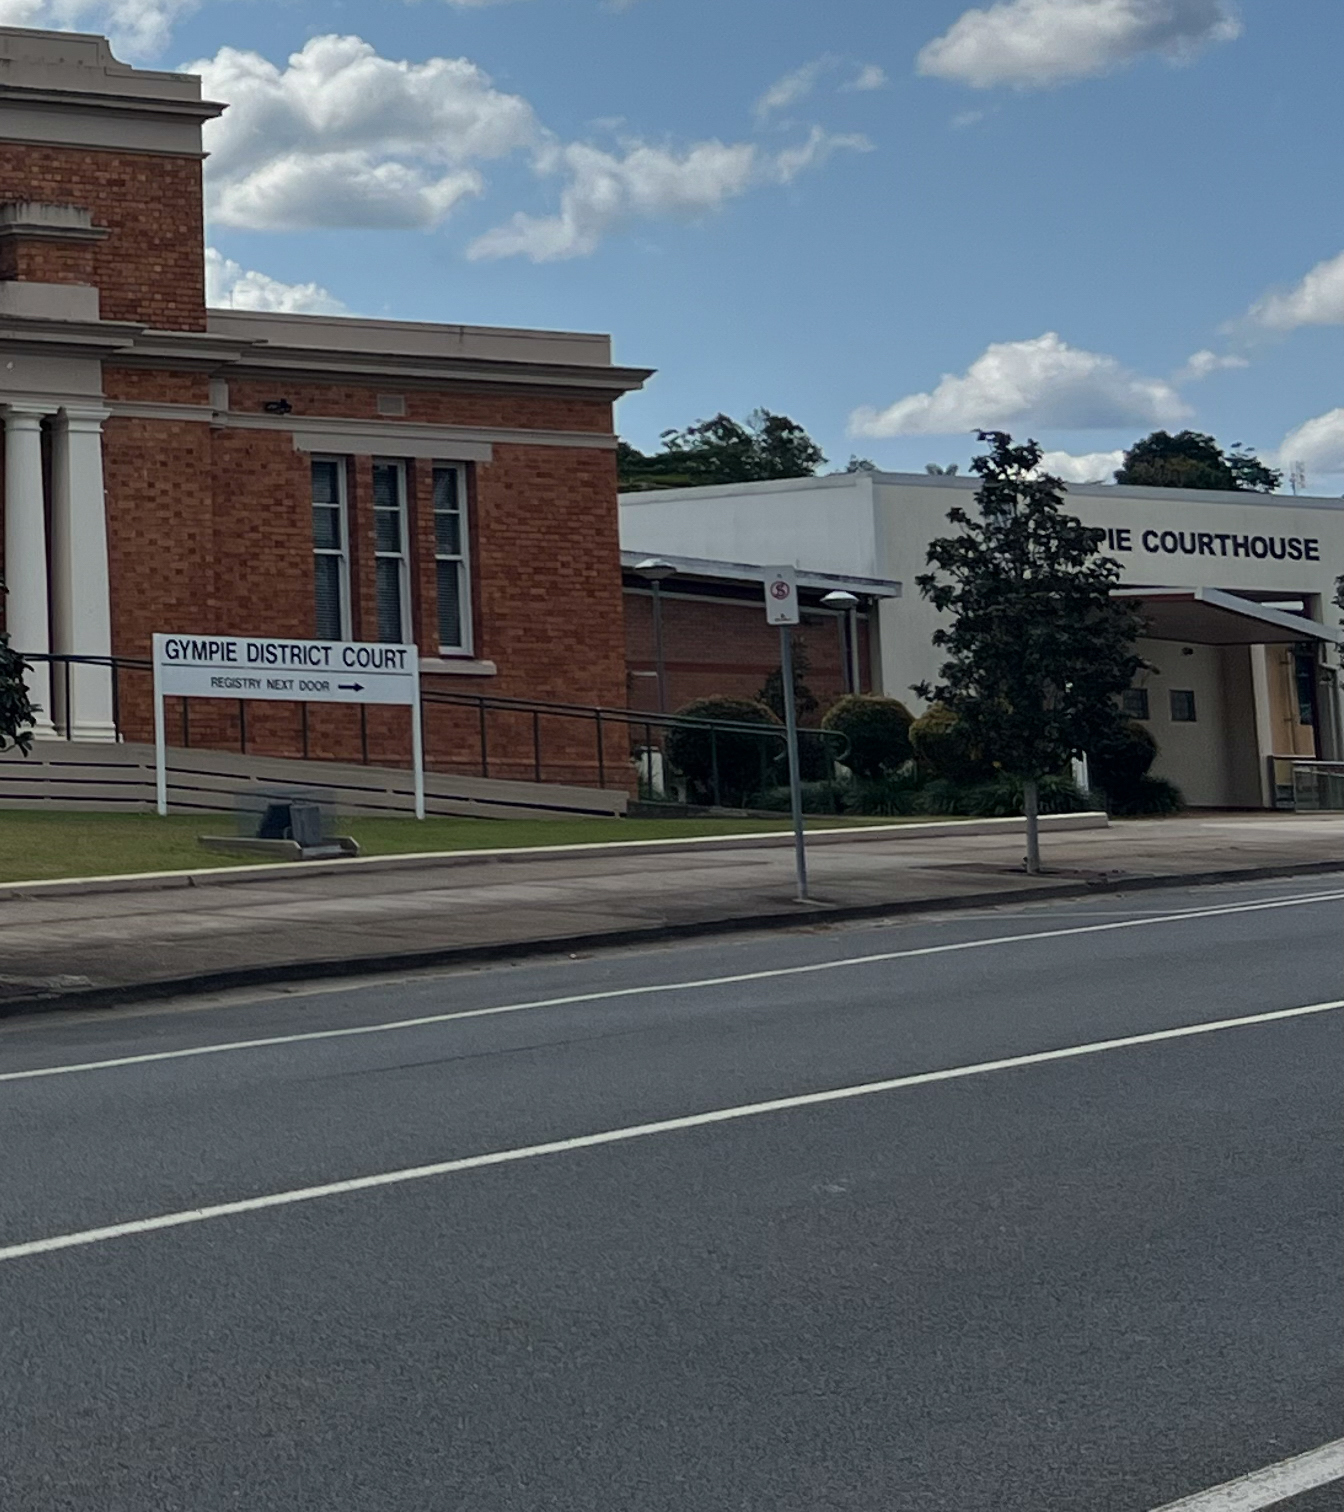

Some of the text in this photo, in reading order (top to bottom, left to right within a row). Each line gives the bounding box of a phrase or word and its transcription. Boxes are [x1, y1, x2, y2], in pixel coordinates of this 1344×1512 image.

[1141, 529, 1321, 562] COURTHOUSE
[165, 638, 408, 669] GYMPIE DISTRICT COURT
[210, 676, 330, 692] REGISTRY NEXT DOOR
